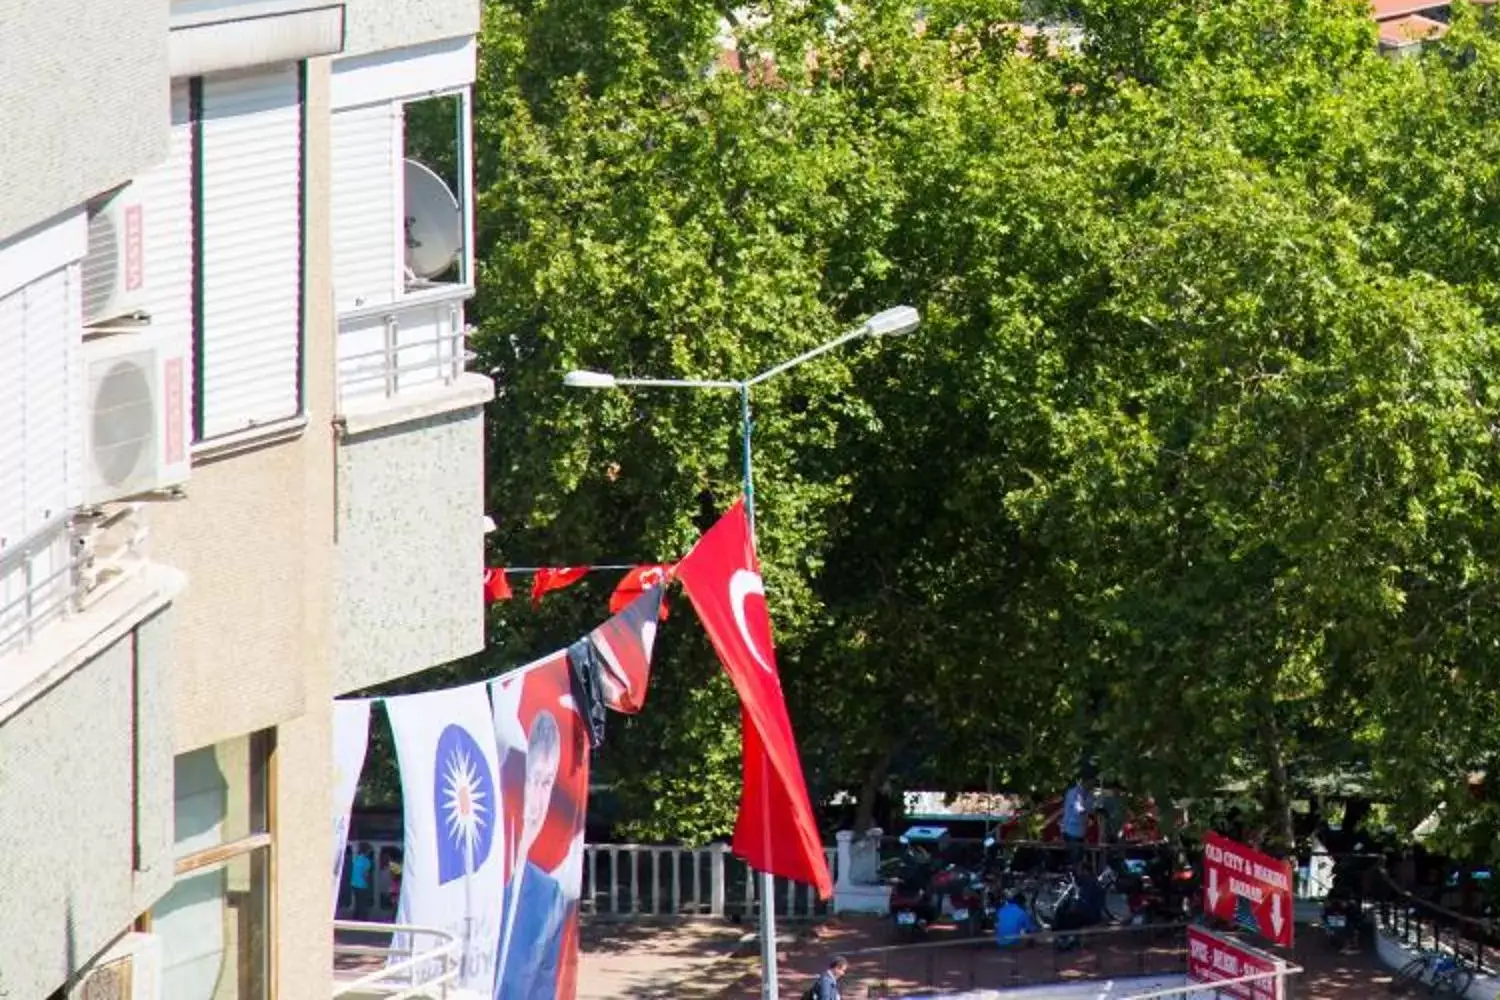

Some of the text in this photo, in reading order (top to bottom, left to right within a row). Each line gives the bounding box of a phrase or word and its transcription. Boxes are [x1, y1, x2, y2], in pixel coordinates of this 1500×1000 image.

[1206, 844, 1222, 863] OLD
[1224, 852, 1244, 872] CITY
[1245, 861, 1253, 876] &
